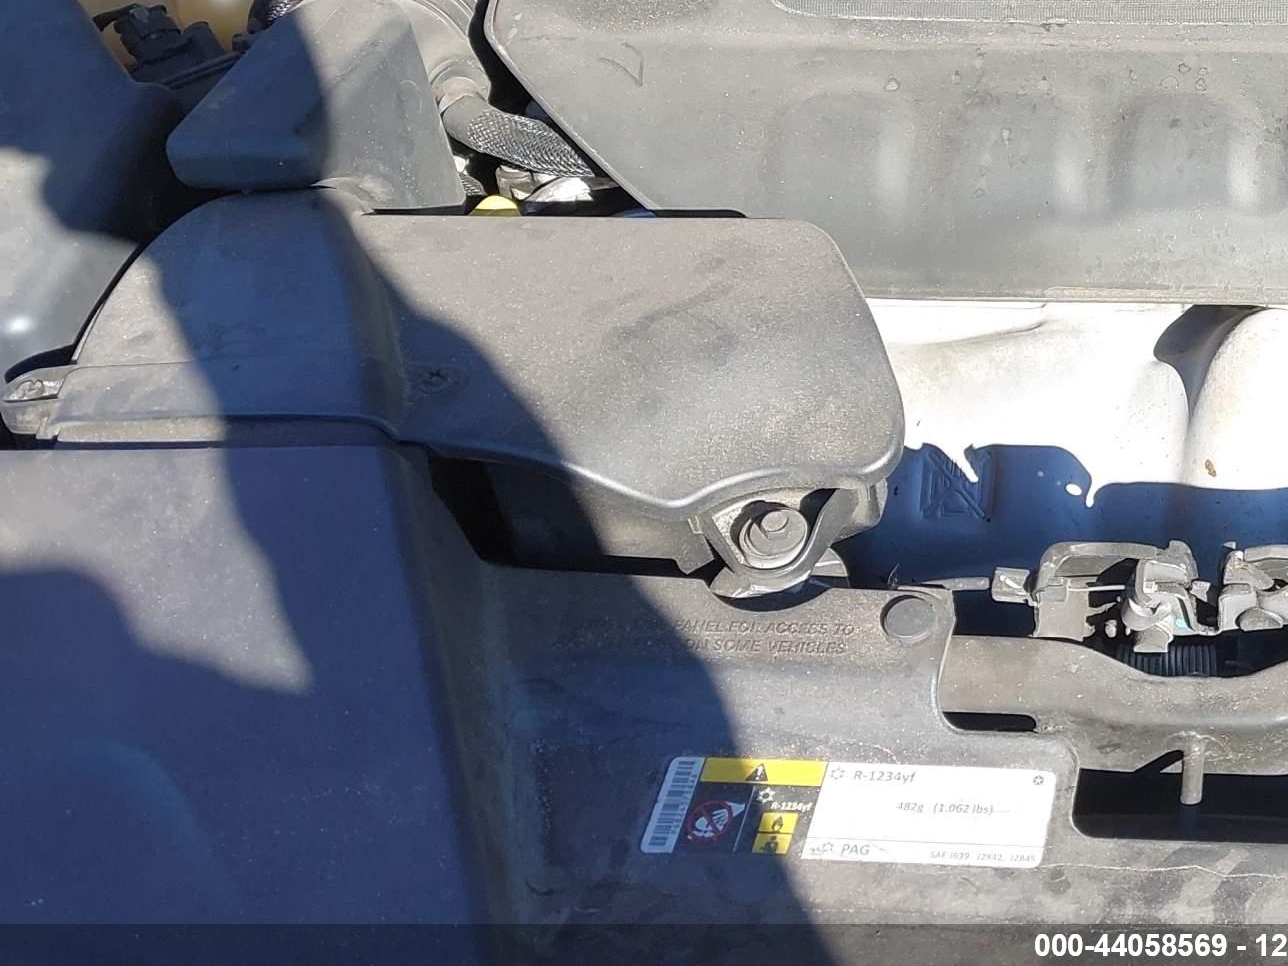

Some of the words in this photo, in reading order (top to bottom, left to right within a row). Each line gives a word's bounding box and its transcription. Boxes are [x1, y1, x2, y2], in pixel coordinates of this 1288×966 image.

[765, 622, 828, 634] ACCESS
[834, 622, 856, 635] TO
[713, 638, 761, 652] SOME
[768, 639, 848, 654] VEHICLES
[854, 770, 916, 784] R-1234yf
[896, 801, 924, 814] 482g
[933, 801, 970, 814] (1.062
[972, 803, 994, 815] lbs)
[840, 843, 870, 856] PAG
[929, 850, 946, 859] SAE
